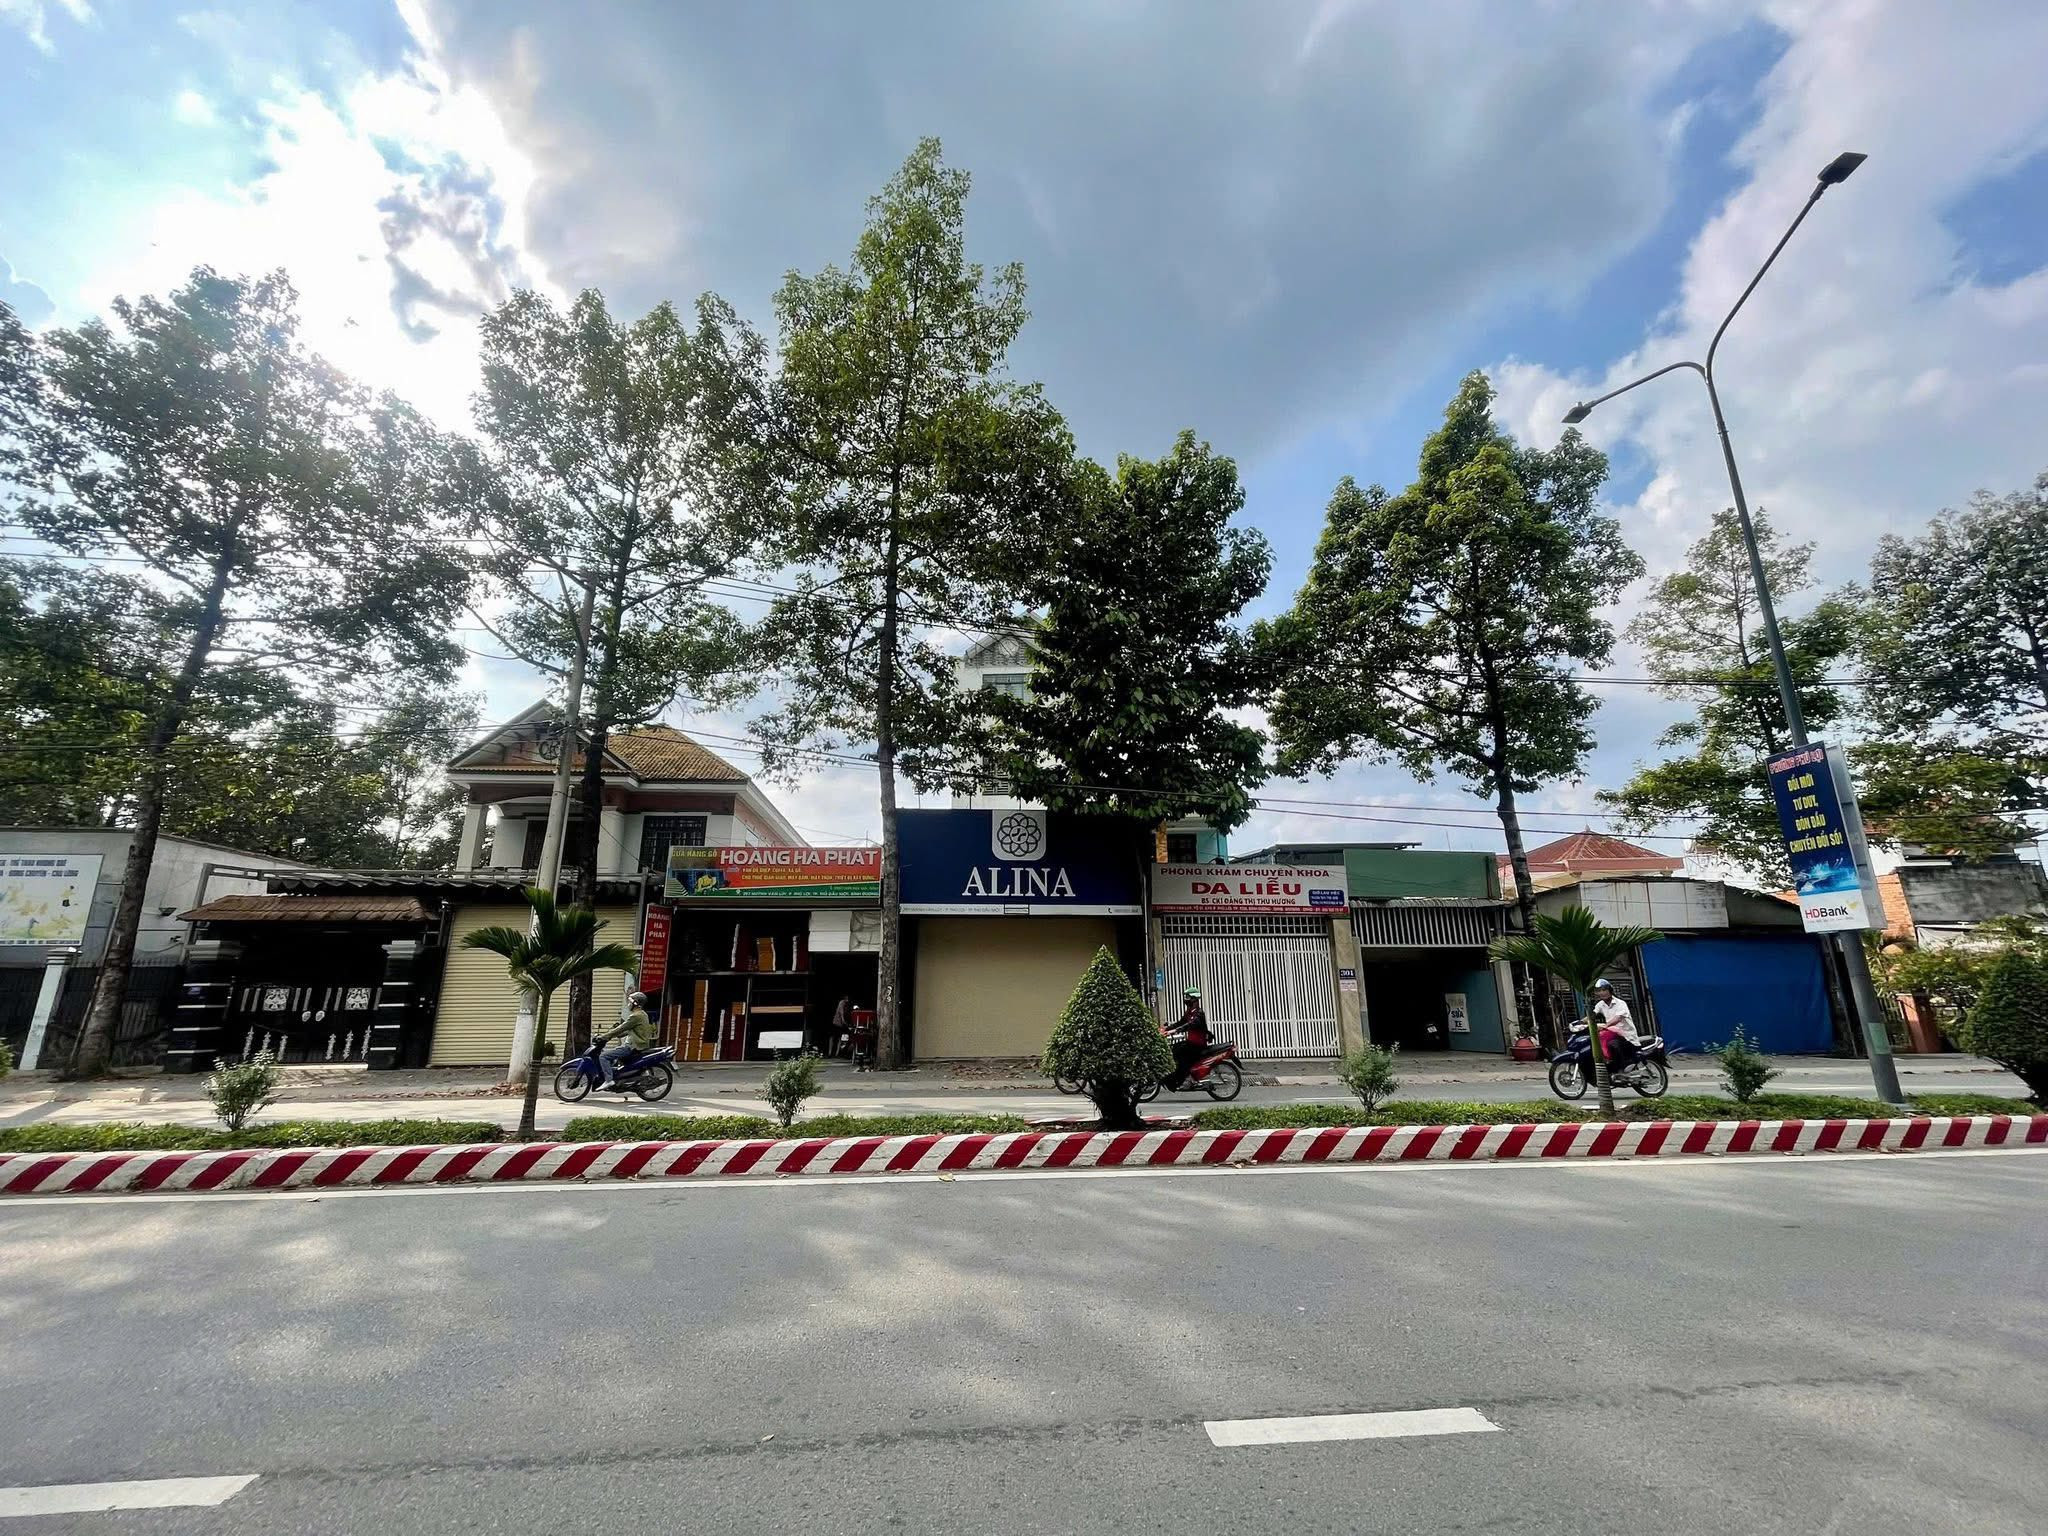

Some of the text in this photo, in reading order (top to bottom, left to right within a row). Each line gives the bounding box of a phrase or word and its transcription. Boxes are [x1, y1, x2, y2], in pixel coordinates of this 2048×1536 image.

[720, 847, 878, 865] HOÀNG HÀ PHÁT
[1244, 867, 1293, 877] CHUYÊN
[1297, 869, 1330, 877] KHOA
[961, 866, 1076, 897] ALINA
[1191, 877, 1302, 896] DA LIỄU
[1805, 905, 1849, 919] HDBank
